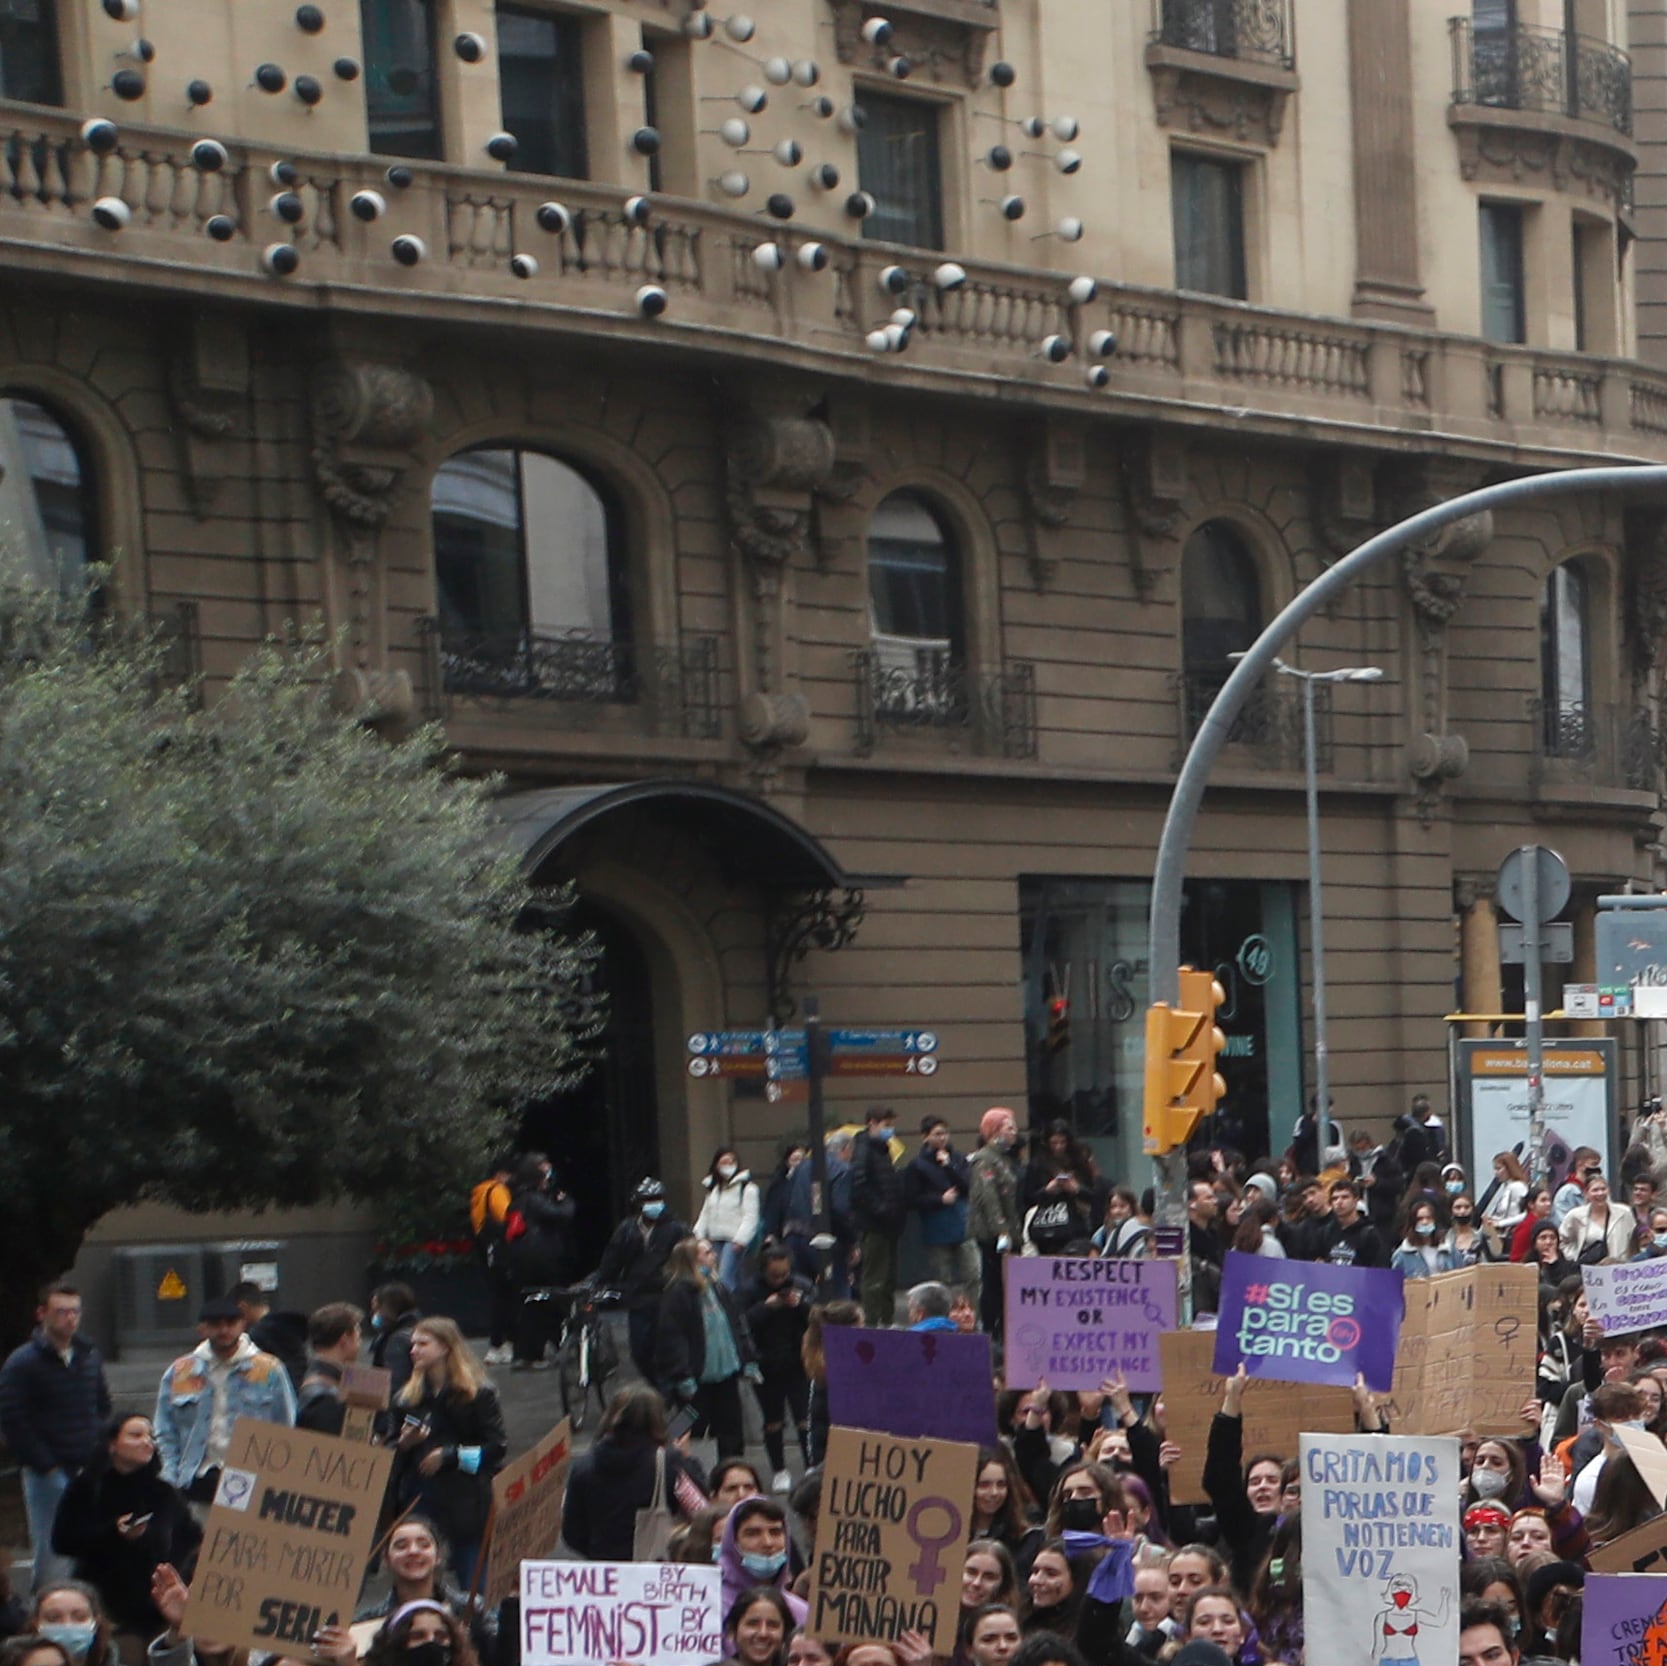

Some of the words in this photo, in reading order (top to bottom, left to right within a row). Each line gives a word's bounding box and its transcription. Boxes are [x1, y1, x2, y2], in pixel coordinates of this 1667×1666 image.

[1052, 1260, 1144, 1283] RESPECT
[1020, 1288, 1052, 1307] MY
[1056, 1287, 1150, 1307] EXISTENCE
[1307, 1291, 1354, 1315] es
[1243, 1305, 1329, 1338] para
[1052, 1331, 1117, 1352] EXPECT
[1124, 1331, 1149, 1350] MY
[1236, 1328, 1341, 1364] tanto
[1048, 1357, 1151, 1373] RESISTANCE
[243, 1433, 290, 1473] NO
[859, 1441, 933, 1483] HOY
[1306, 1449, 1439, 1486] GRITAMOS
[258, 1486, 356, 1537] MUJER
[829, 1476, 908, 1523] LUCHO
[1402, 1492, 1435, 1517] QUE
[834, 1520, 881, 1555] PARA
[208, 1527, 268, 1571] PARA
[278, 1541, 355, 1590] MORIR
[817, 1553, 892, 1594] EXISTIR
[1336, 1547, 1394, 1580] VOZ
[200, 1570, 245, 1611] POR
[525, 1566, 619, 1598] FEMALE
[659, 1565, 688, 1583] BY
[643, 1582, 708, 1602] BIRTH
[524, 1602, 673, 1661] FEMINIST
[680, 1607, 712, 1633] BY
[661, 1632, 722, 1656] CHOICE
[1613, 1638, 1651, 1663] TOT
